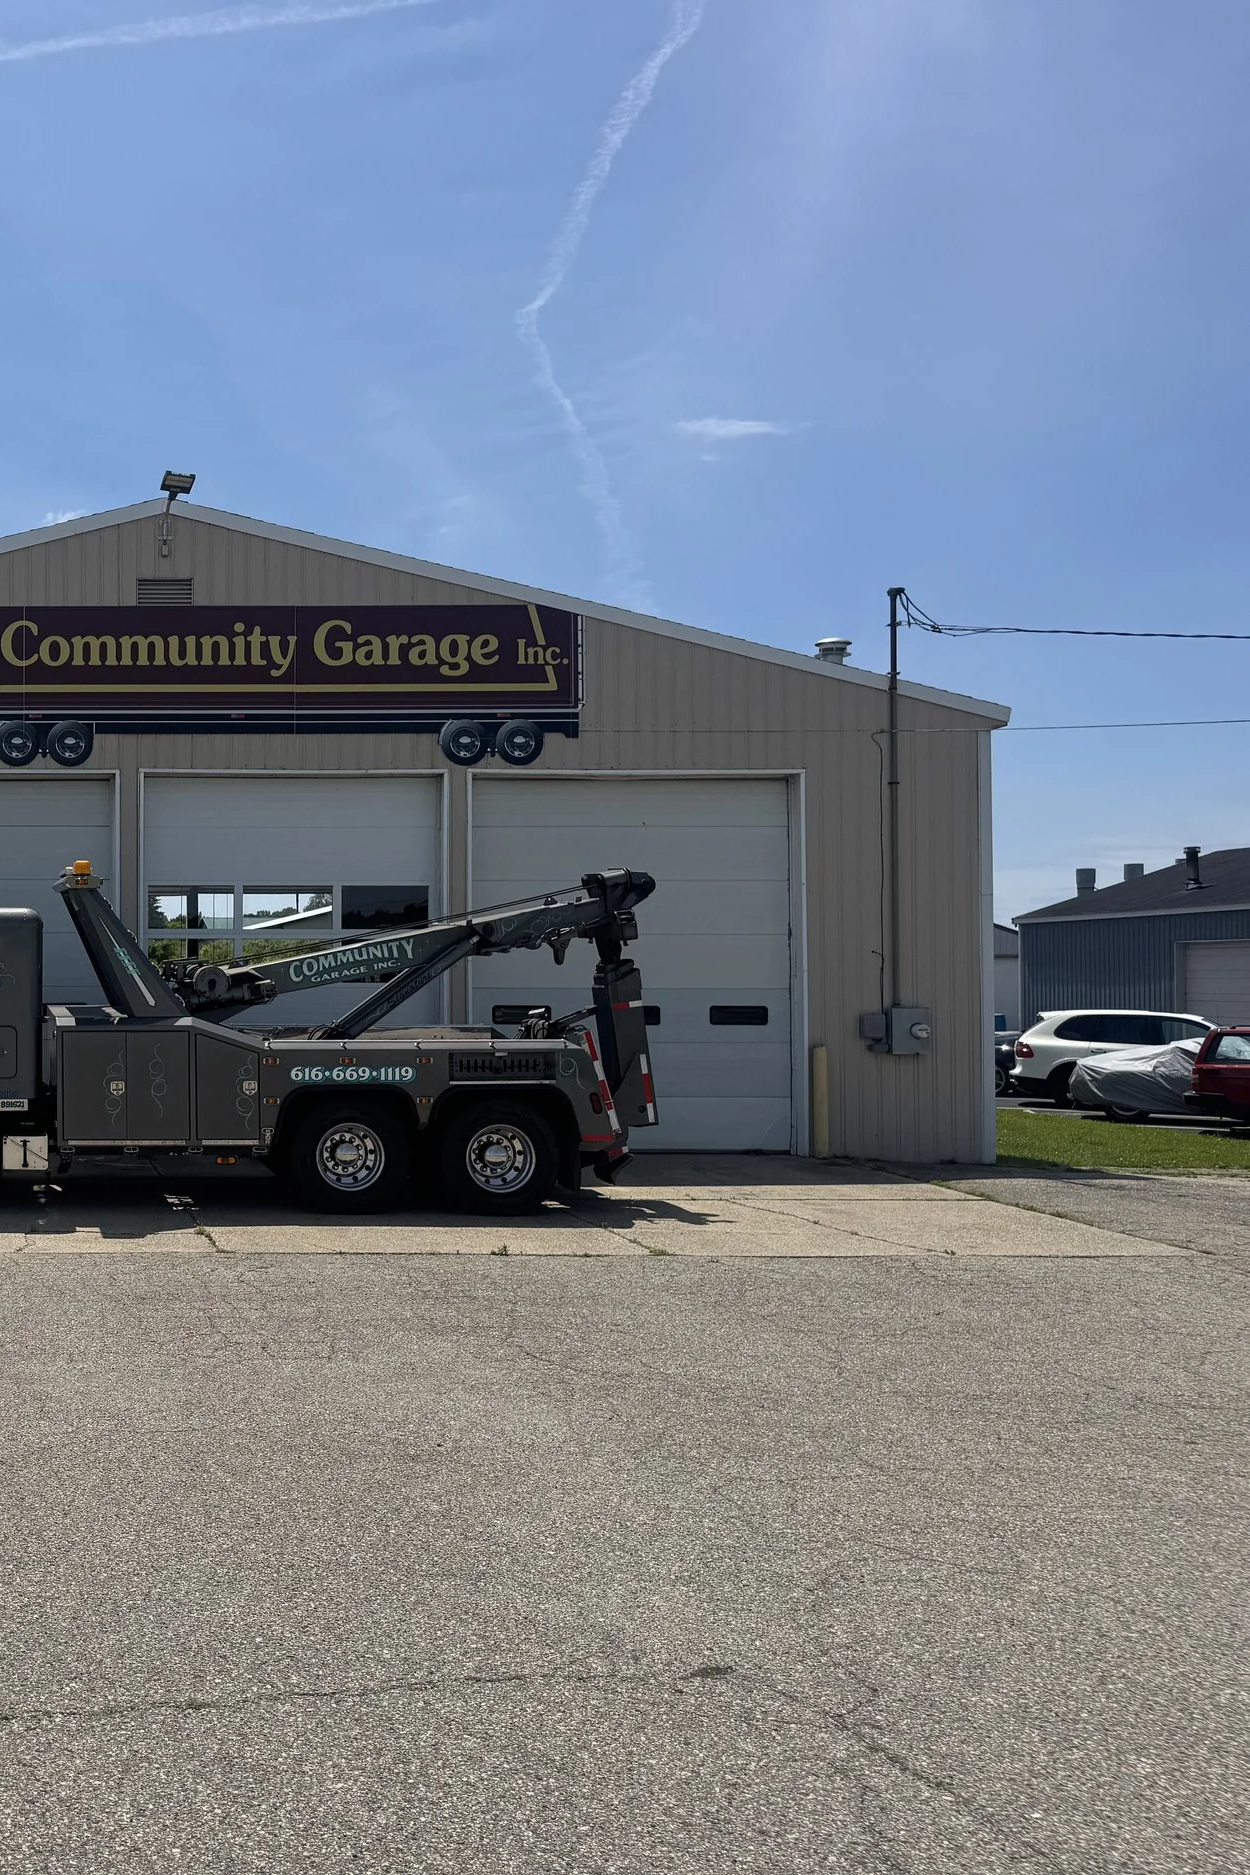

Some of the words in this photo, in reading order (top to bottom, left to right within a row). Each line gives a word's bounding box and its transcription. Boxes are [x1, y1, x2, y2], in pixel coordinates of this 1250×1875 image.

[0, 619, 297, 678] Community
[313, 619, 500, 677] Garage
[517, 637, 569, 666] Inc.
[289, 938, 415, 983] COMMUNITY
[311, 966, 368, 983] GARAGE
[374, 960, 401, 970] INC.
